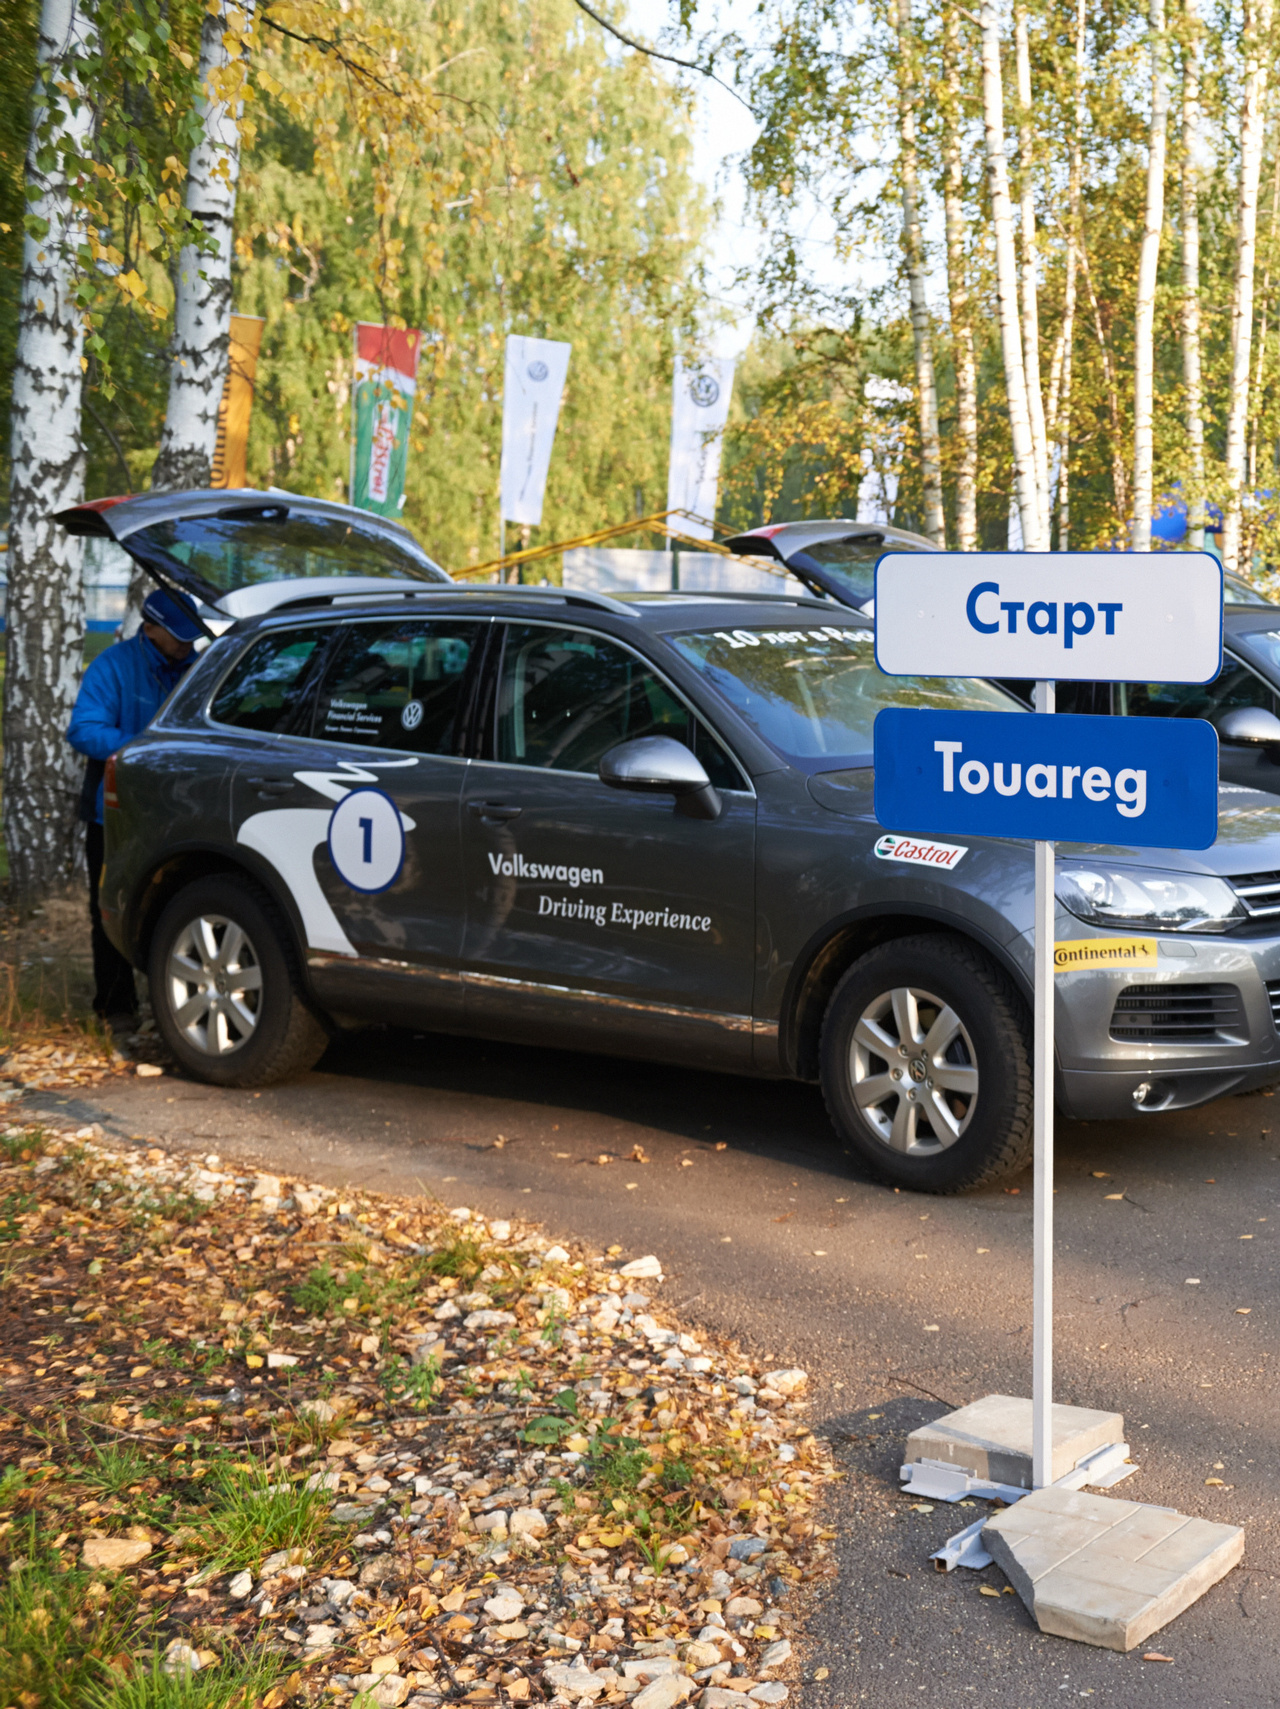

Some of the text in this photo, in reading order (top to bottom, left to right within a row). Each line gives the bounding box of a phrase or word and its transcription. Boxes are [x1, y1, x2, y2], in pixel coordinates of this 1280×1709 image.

[966, 581, 1123, 649] Старт
[713, 629, 761, 649] 10
[762, 631, 808, 645] лет
[934, 740, 1147, 818] Touareg
[359, 817, 373, 864] 1
[893, 840, 959, 865] Castrol
[488, 852, 604, 888] Volkswagen
[538, 895, 712, 932] Driving Experience
[1054, 944, 1137, 967] Continental
